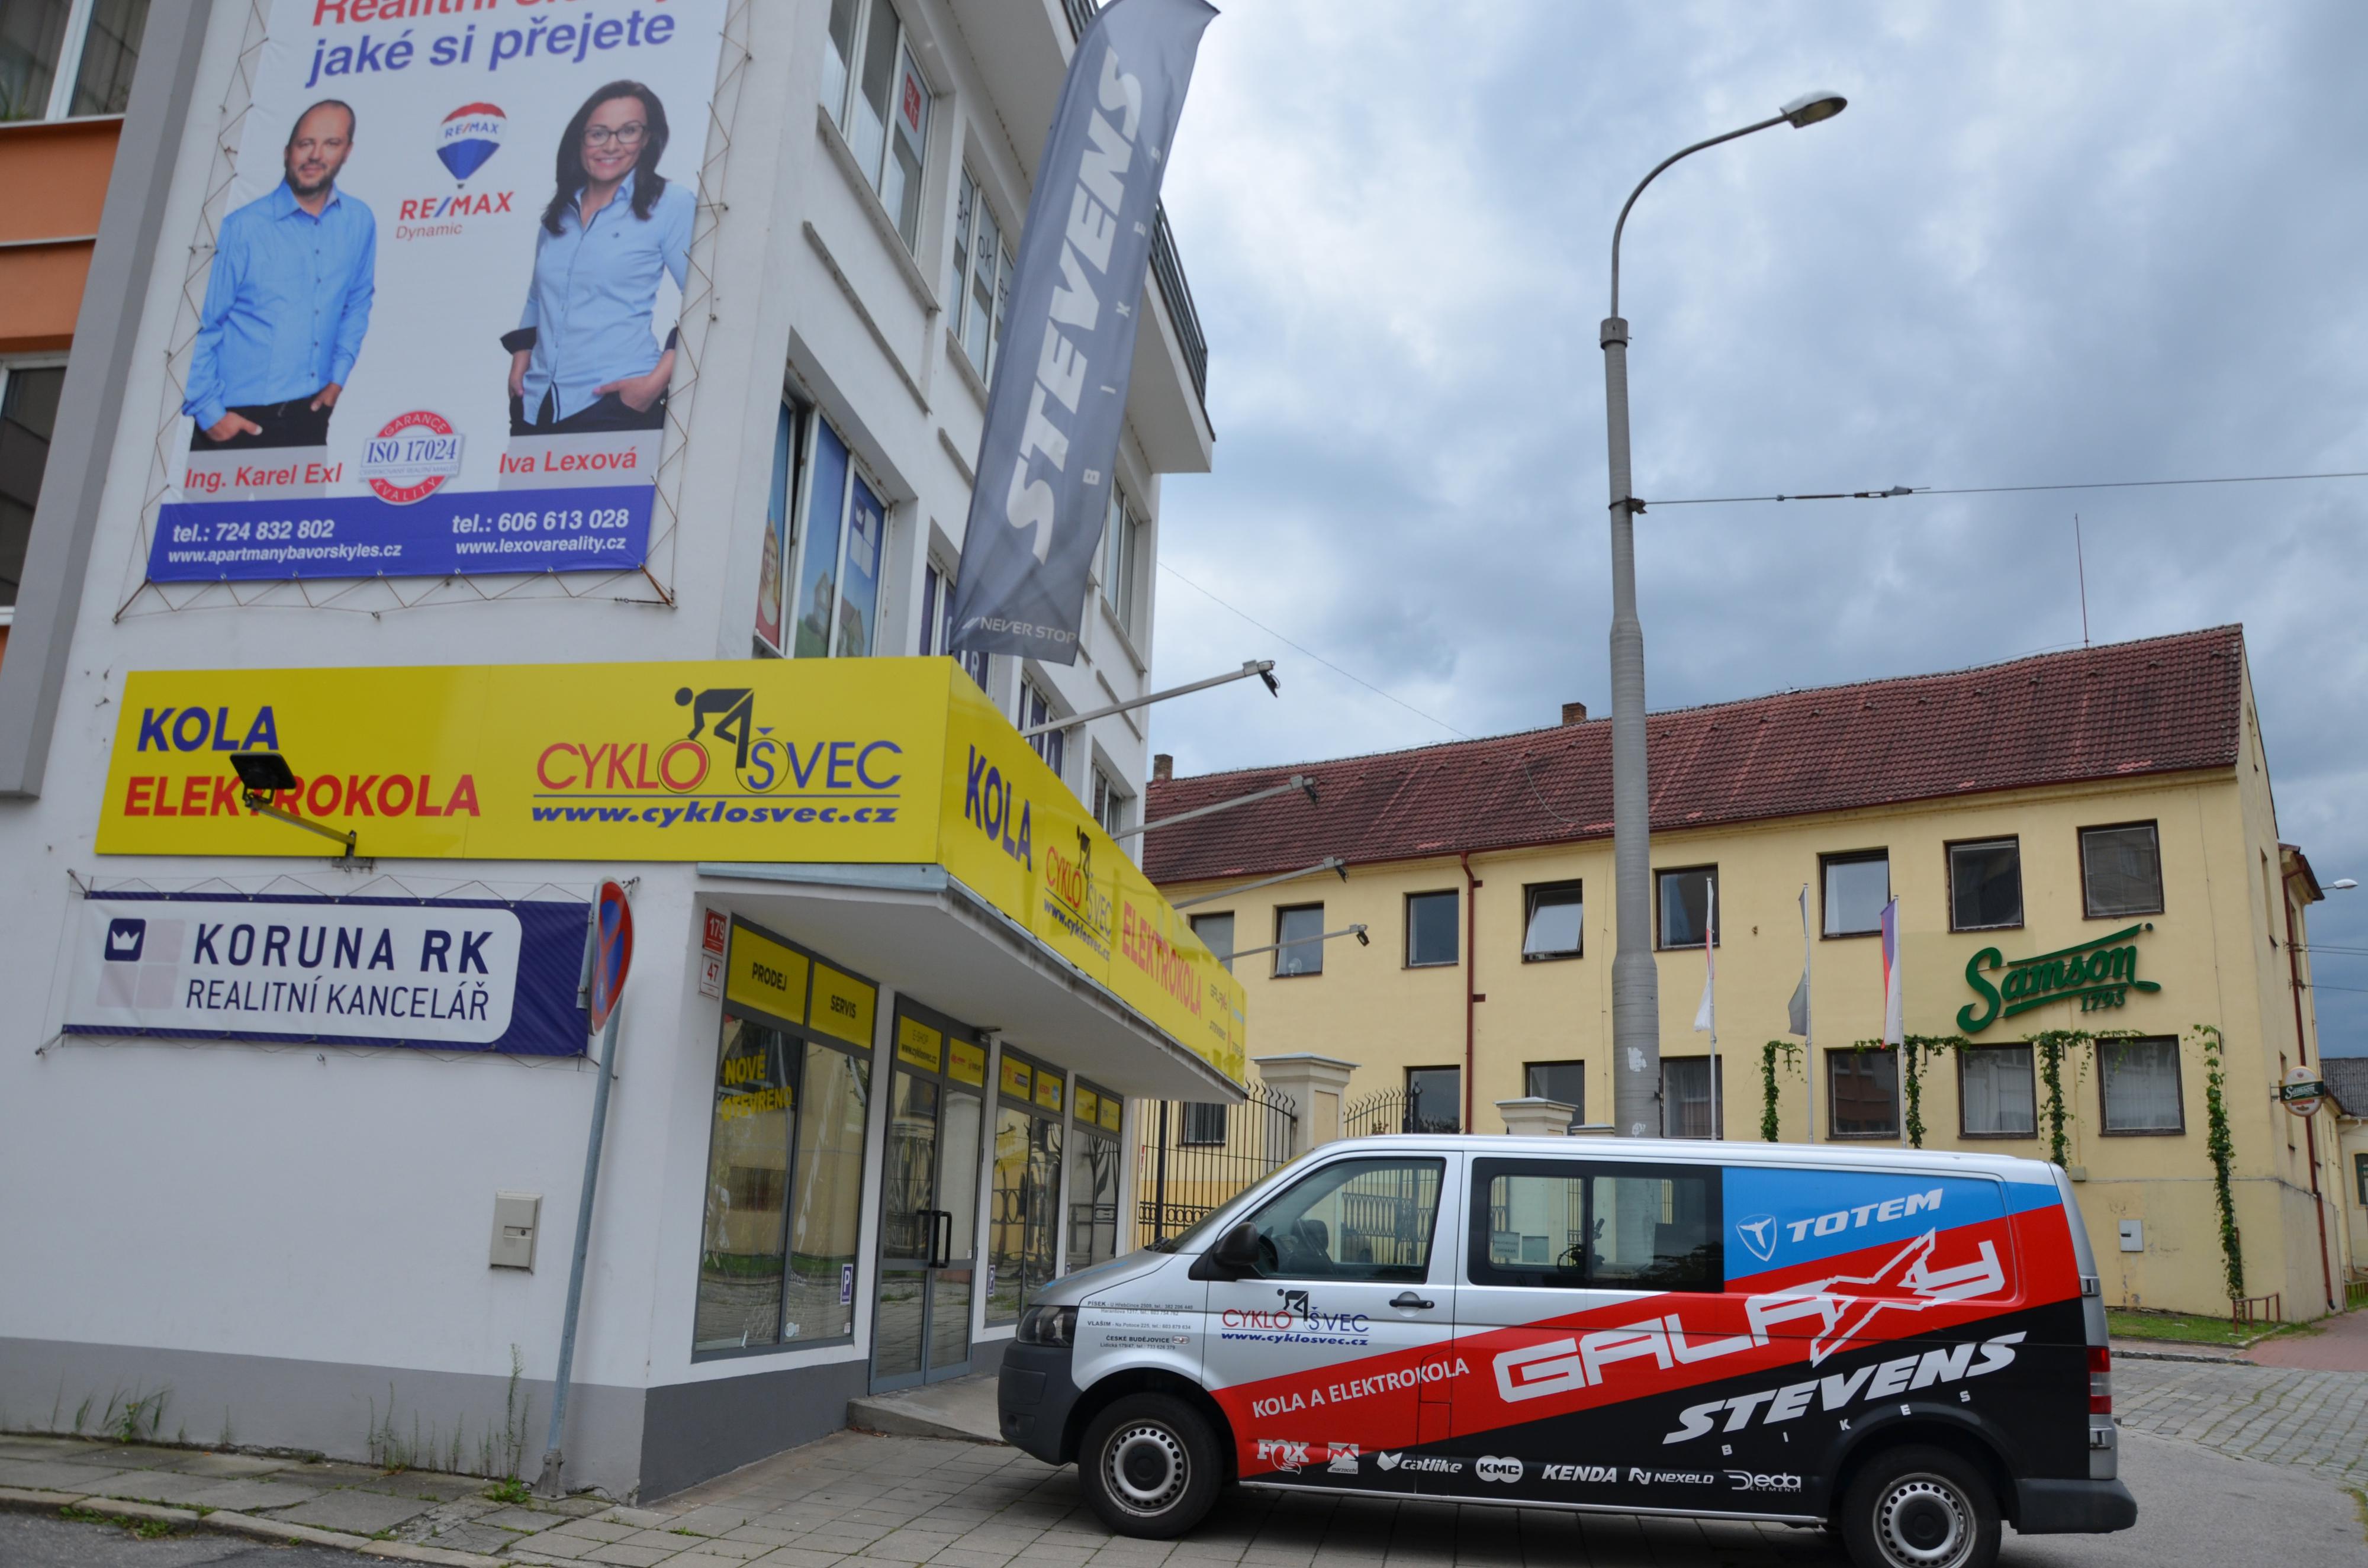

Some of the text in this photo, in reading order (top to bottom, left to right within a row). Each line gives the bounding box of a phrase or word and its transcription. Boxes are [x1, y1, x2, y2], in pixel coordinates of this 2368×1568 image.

[305, 30, 414, 88] jaké
[430, 25, 475, 66] si
[488, 10, 675, 72] přejete
[445, 121, 499, 139] RE/MAX
[400, 191, 514, 220] RE/MAX
[396, 223, 463, 241] Dynamic
[1006, 45, 1143, 565] STEVENS
[385, 414, 447, 436] GARANCE
[366, 438, 456, 463] ISO 17024
[499, 446, 638, 475] Iva Lexová
[184, 468, 227, 494] Ing.
[235, 464, 297, 487] Karel
[305, 462, 342, 483] Exl
[374, 478, 436, 501] KVALITY
[172, 519, 335, 542] tel.: 724 832 802
[452, 508, 629, 534] tel.: 606 613 028
[168, 543, 402, 563] www.apartmanybavorskyles.cz
[456, 536, 626, 556] www.lexovareality.cz
[980, 616, 1077, 643] NEVER STOP
[137, 706, 279, 752] KOLA
[537, 727, 903, 791] CYKLO ŠVEC
[123, 774, 481, 817] ELEKROKOLA
[965, 743, 1032, 872] KOLA
[532, 801, 899, 828] www.cyklosvec.cz
[1047, 846, 1113, 937] CYKLO ŠVEC
[709, 917, 725, 941] 179
[1044, 899, 1110, 961] www.cyklosvec.cz
[193, 923, 494, 975] KORUNA RK
[1121, 899, 1202, 1019] ELEKTROKOLA
[707, 962, 719, 983] 47
[752, 961, 787, 992] PRODEJ
[186, 976, 490, 1021] REALITNÍ KANCELÁŘ
[1956, 944, 2161, 1033] Samson
[2081, 987, 2126, 1013] 1795
[830, 994, 857, 1019] SERVIS
[1787, 1189, 1944, 1242] TOTEM
[1222, 1306, 1369, 1333] CYKLO ŠVEC
[1492, 1227, 2006, 1403] GALAXY
[1221, 1333, 1368, 1345] www.cyklosvec.cz
[1252, 1357, 1470, 1419] KOLA A ELEKTROKOLA
[1662, 1331, 2027, 1444] STEVENS
[1257, 1439, 1310, 1469] FOX
[1400, 1457, 1462, 1473] catlike
[1480, 1463, 1520, 1476] KMC
[1542, 1464, 1617, 1483] KENDA
[1723, 1469, 1801, 1490] Deda
